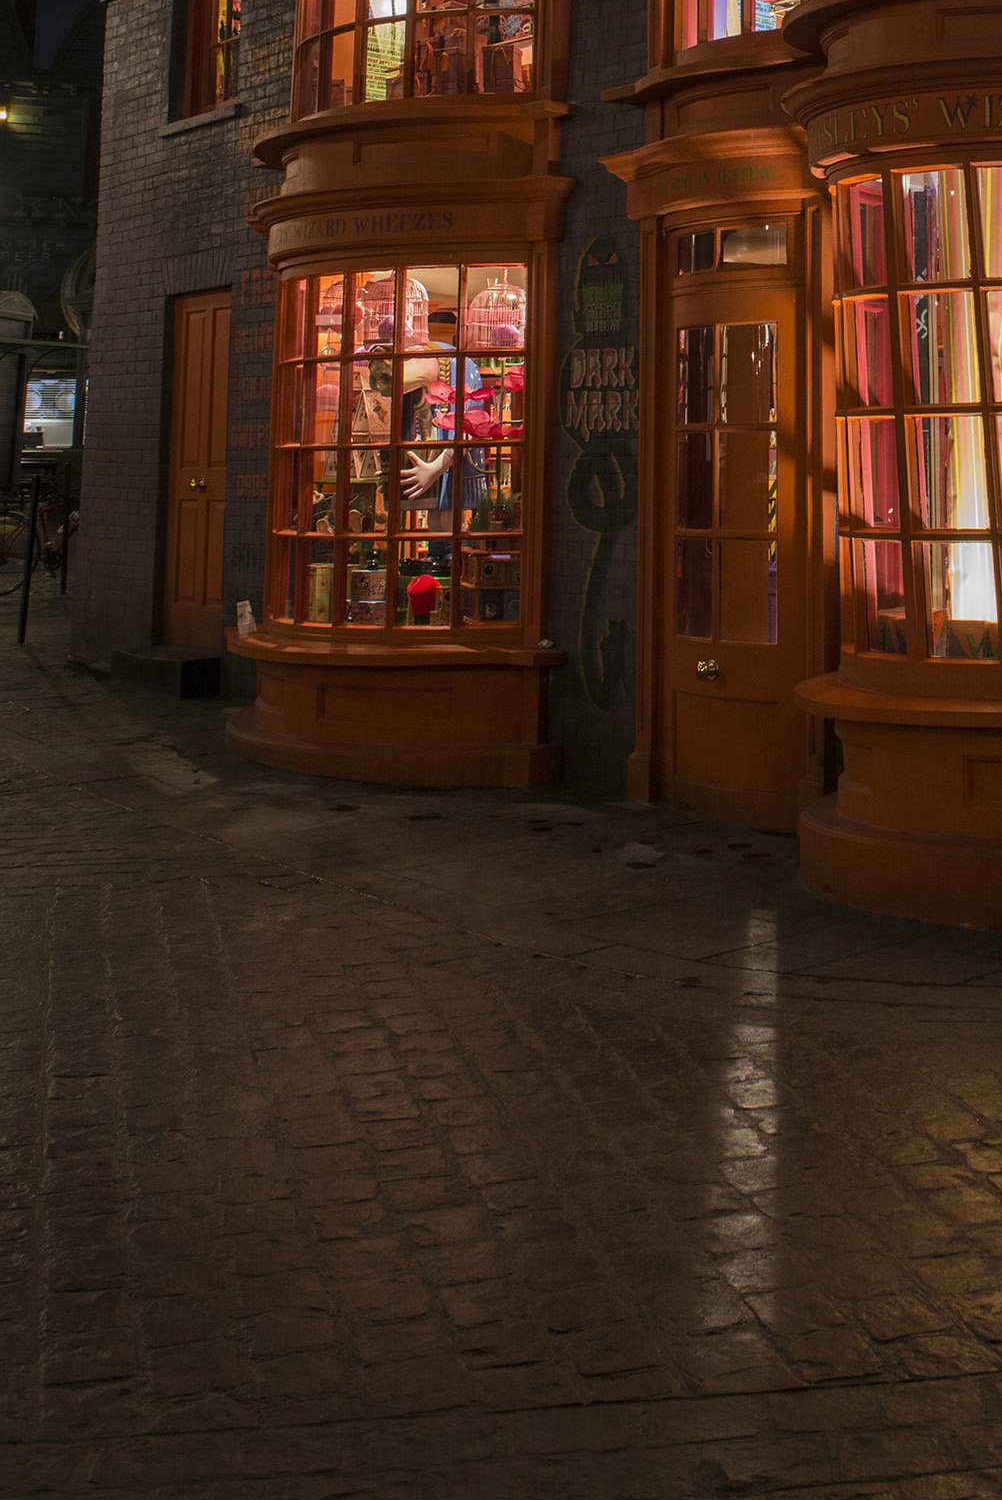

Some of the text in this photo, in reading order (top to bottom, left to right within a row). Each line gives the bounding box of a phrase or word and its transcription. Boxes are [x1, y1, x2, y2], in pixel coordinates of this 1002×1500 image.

[353, 210, 454, 236] WHEEZES
[569, 345, 636, 389] DARK
[563, 388, 640, 439] MARK
